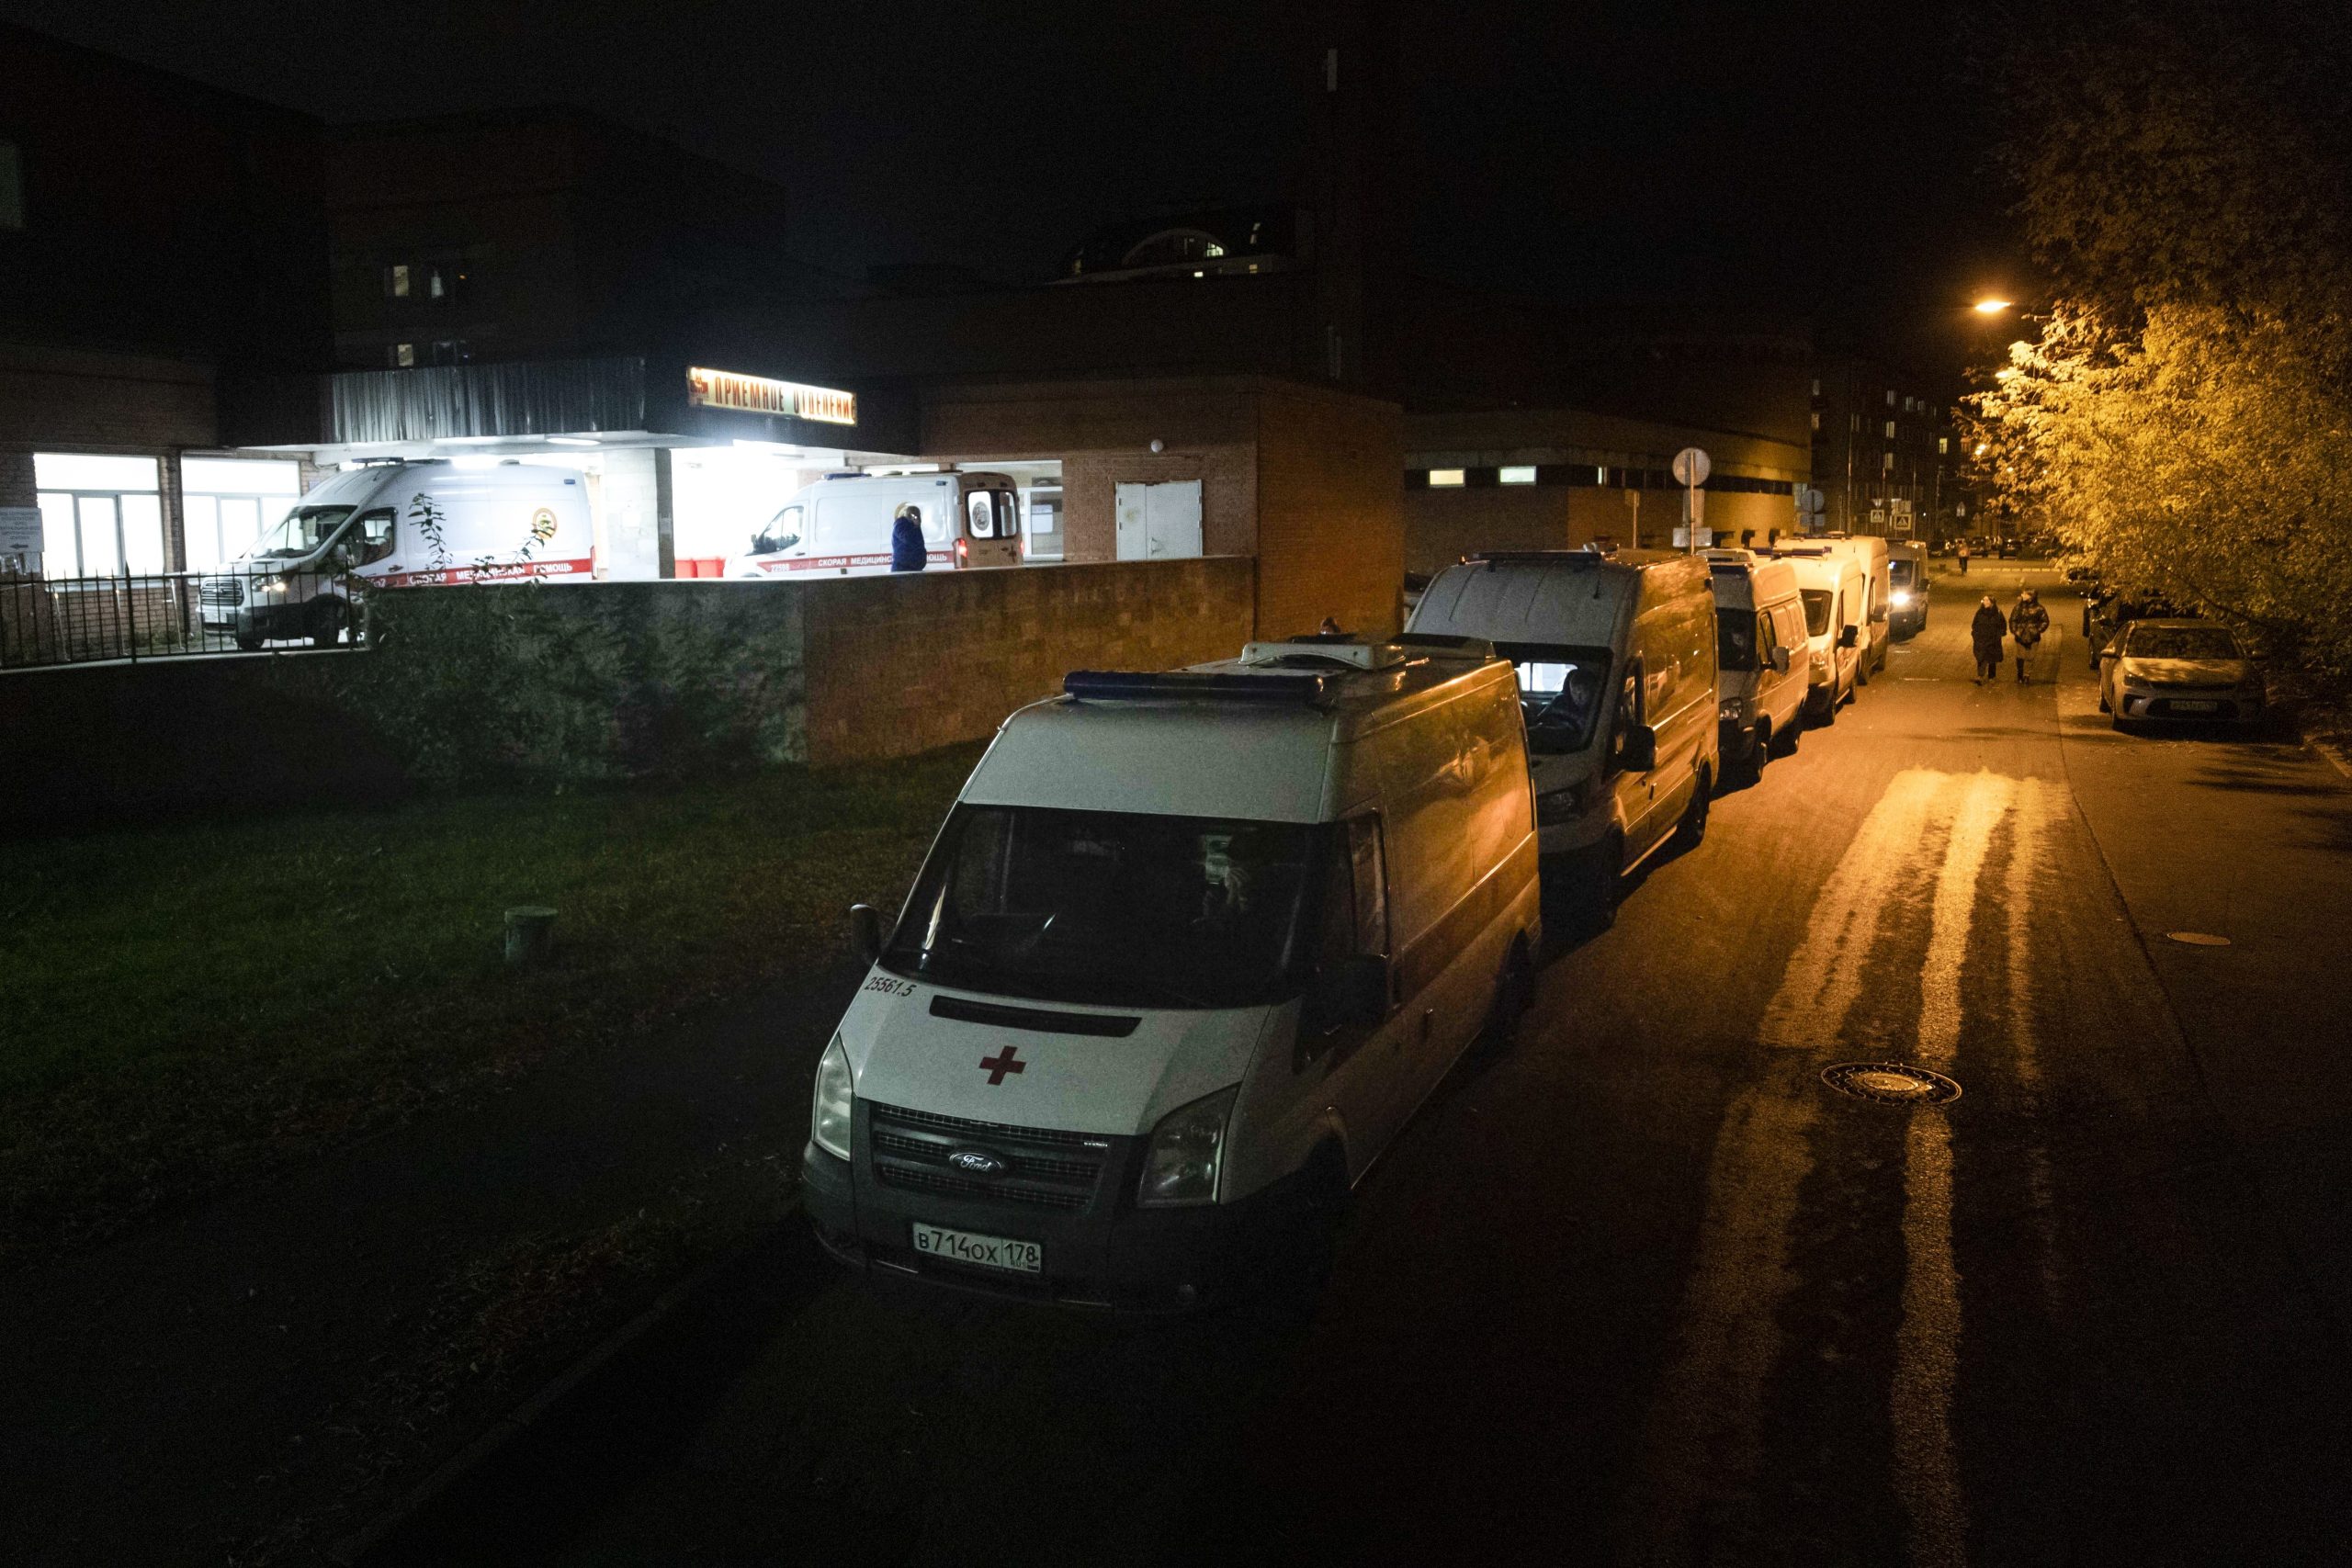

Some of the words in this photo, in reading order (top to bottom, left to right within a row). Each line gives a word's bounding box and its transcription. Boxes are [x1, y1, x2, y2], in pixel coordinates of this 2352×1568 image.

[715, 376, 785, 412] ПРИЕМНОЕ
[793, 389, 856, 421] ОТДЕЛЕНИЕ
[534, 562, 572, 574] ПОМОЩЬ
[818, 558, 846, 567] СКОРАЯ
[851, 555, 893, 566] МЕДИЦИНС
[865, 976, 917, 997] 25561.5
[960, 1155, 992, 1172] Ford
[1003, 1243, 1035, 1263] 178
